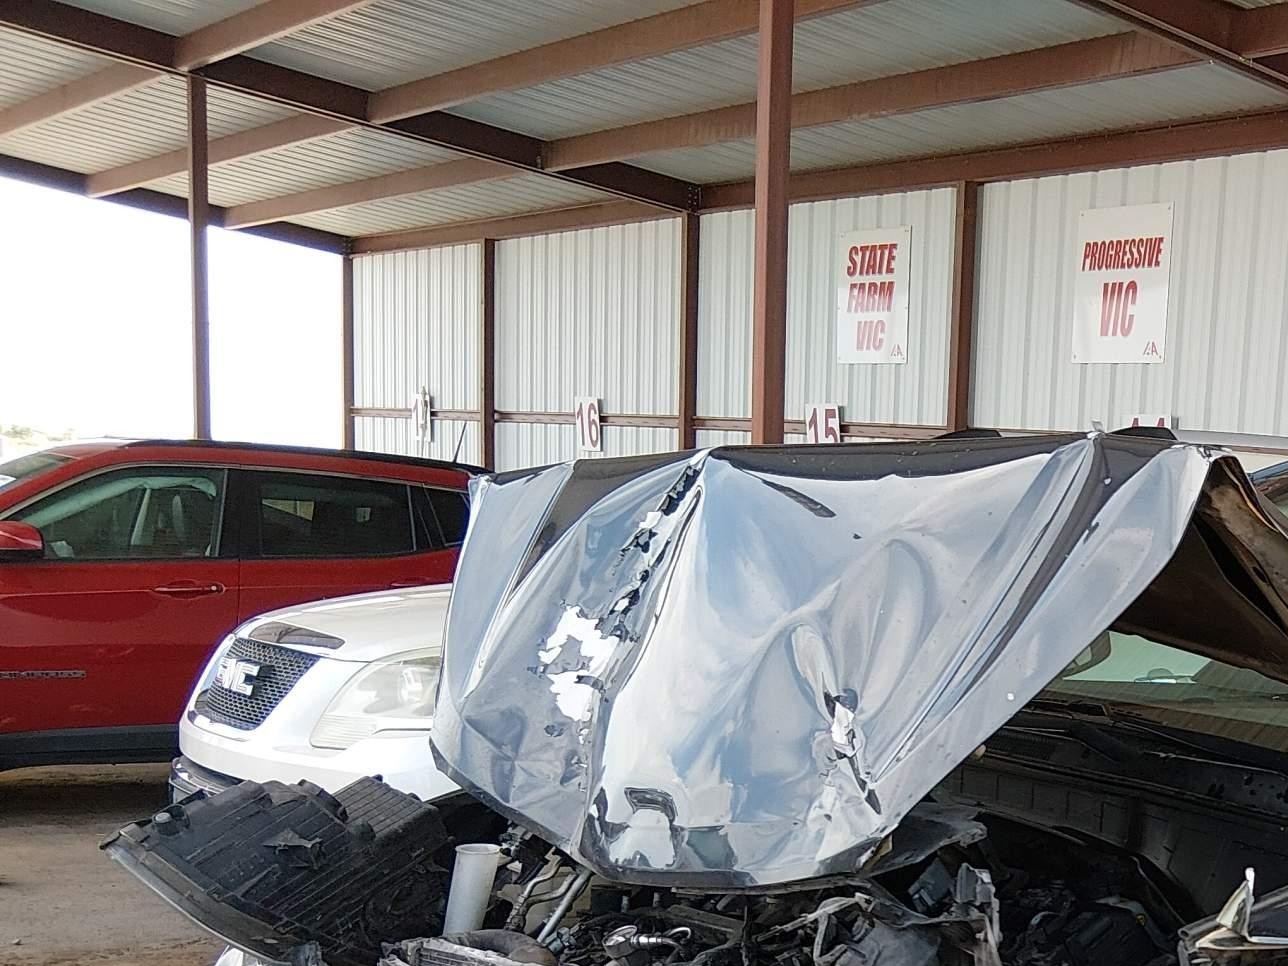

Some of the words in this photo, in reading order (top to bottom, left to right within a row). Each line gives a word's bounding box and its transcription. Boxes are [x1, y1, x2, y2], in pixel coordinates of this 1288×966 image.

[847, 243, 898, 277] STATE
[1082, 237, 1164, 272] PROGRESSIVE
[847, 281, 896, 313] FARM
[1100, 280, 1138, 337] VIC
[856, 319, 887, 351] VIC
[577, 402, 600, 448] 16
[808, 408, 839, 443] 15
